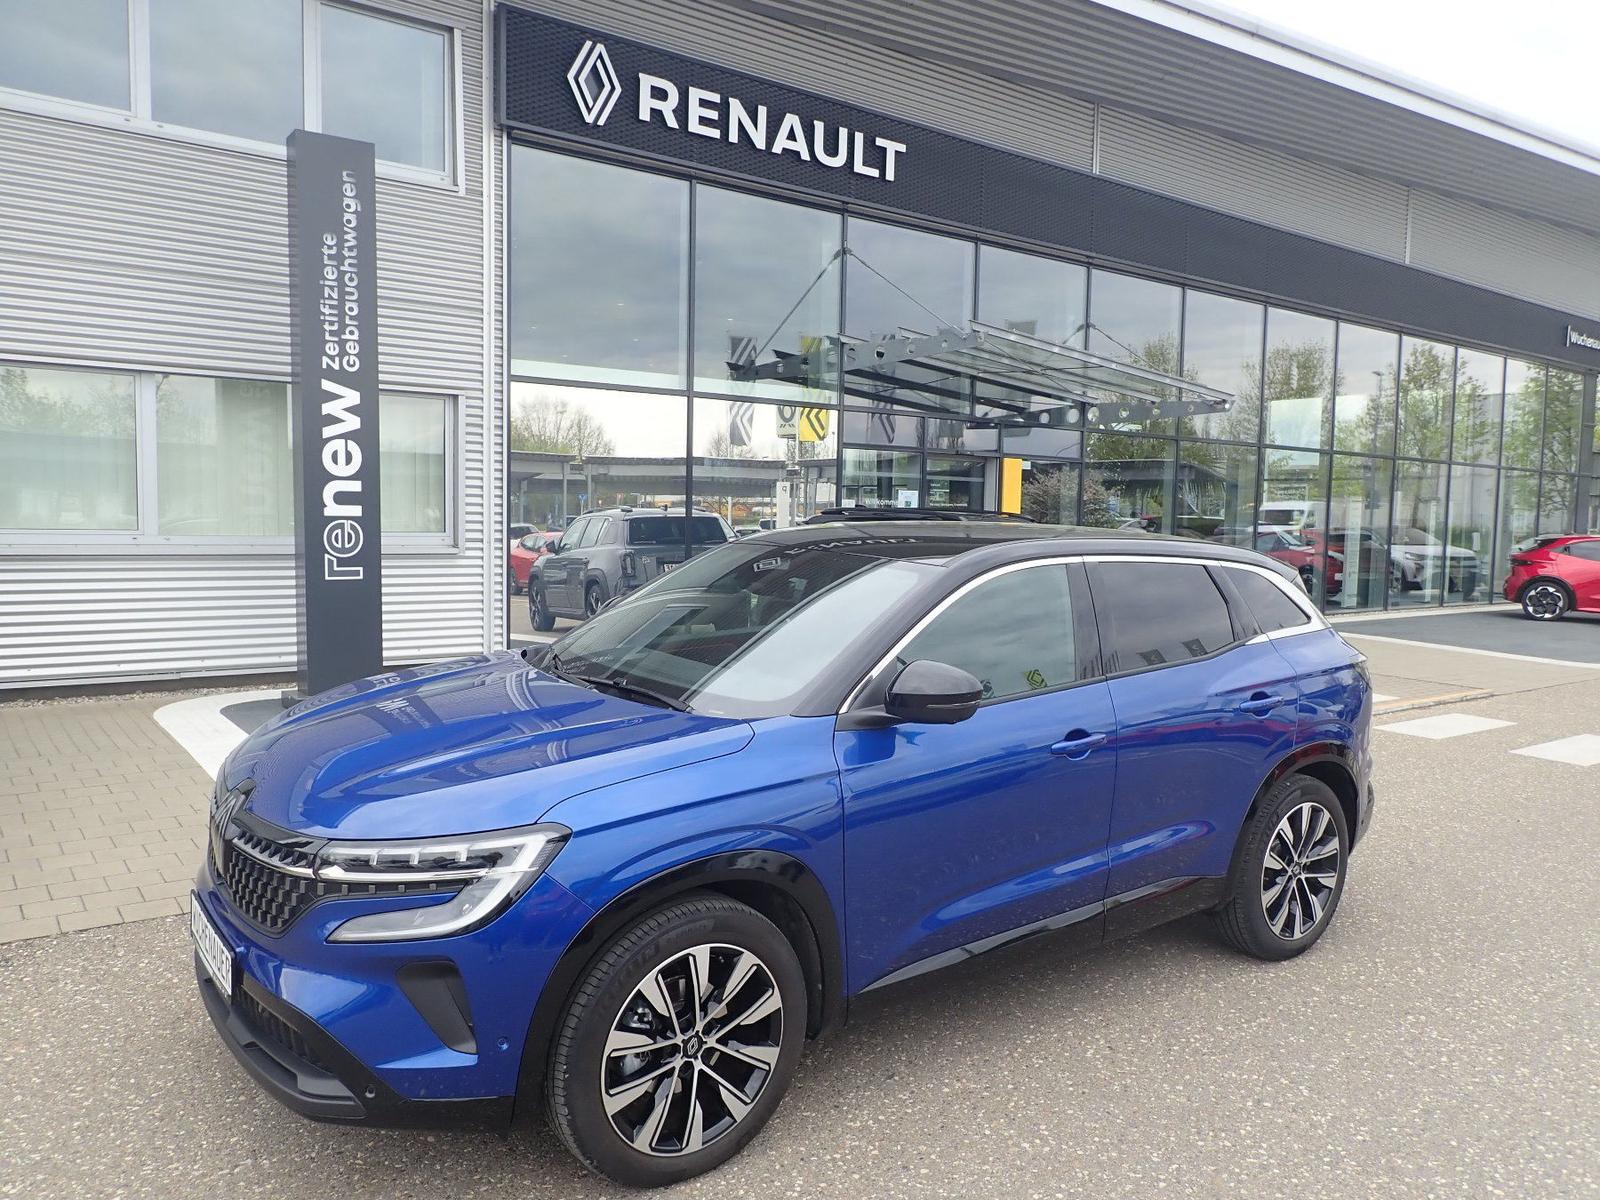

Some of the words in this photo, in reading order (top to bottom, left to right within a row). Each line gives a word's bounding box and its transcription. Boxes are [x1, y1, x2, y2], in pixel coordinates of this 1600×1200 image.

[638, 72, 907, 183] RENAULT
[320, 232, 340, 371] Zertifizierte
[340, 169, 361, 373] Gebrauchtwagen
[321, 378, 363, 580] renew
